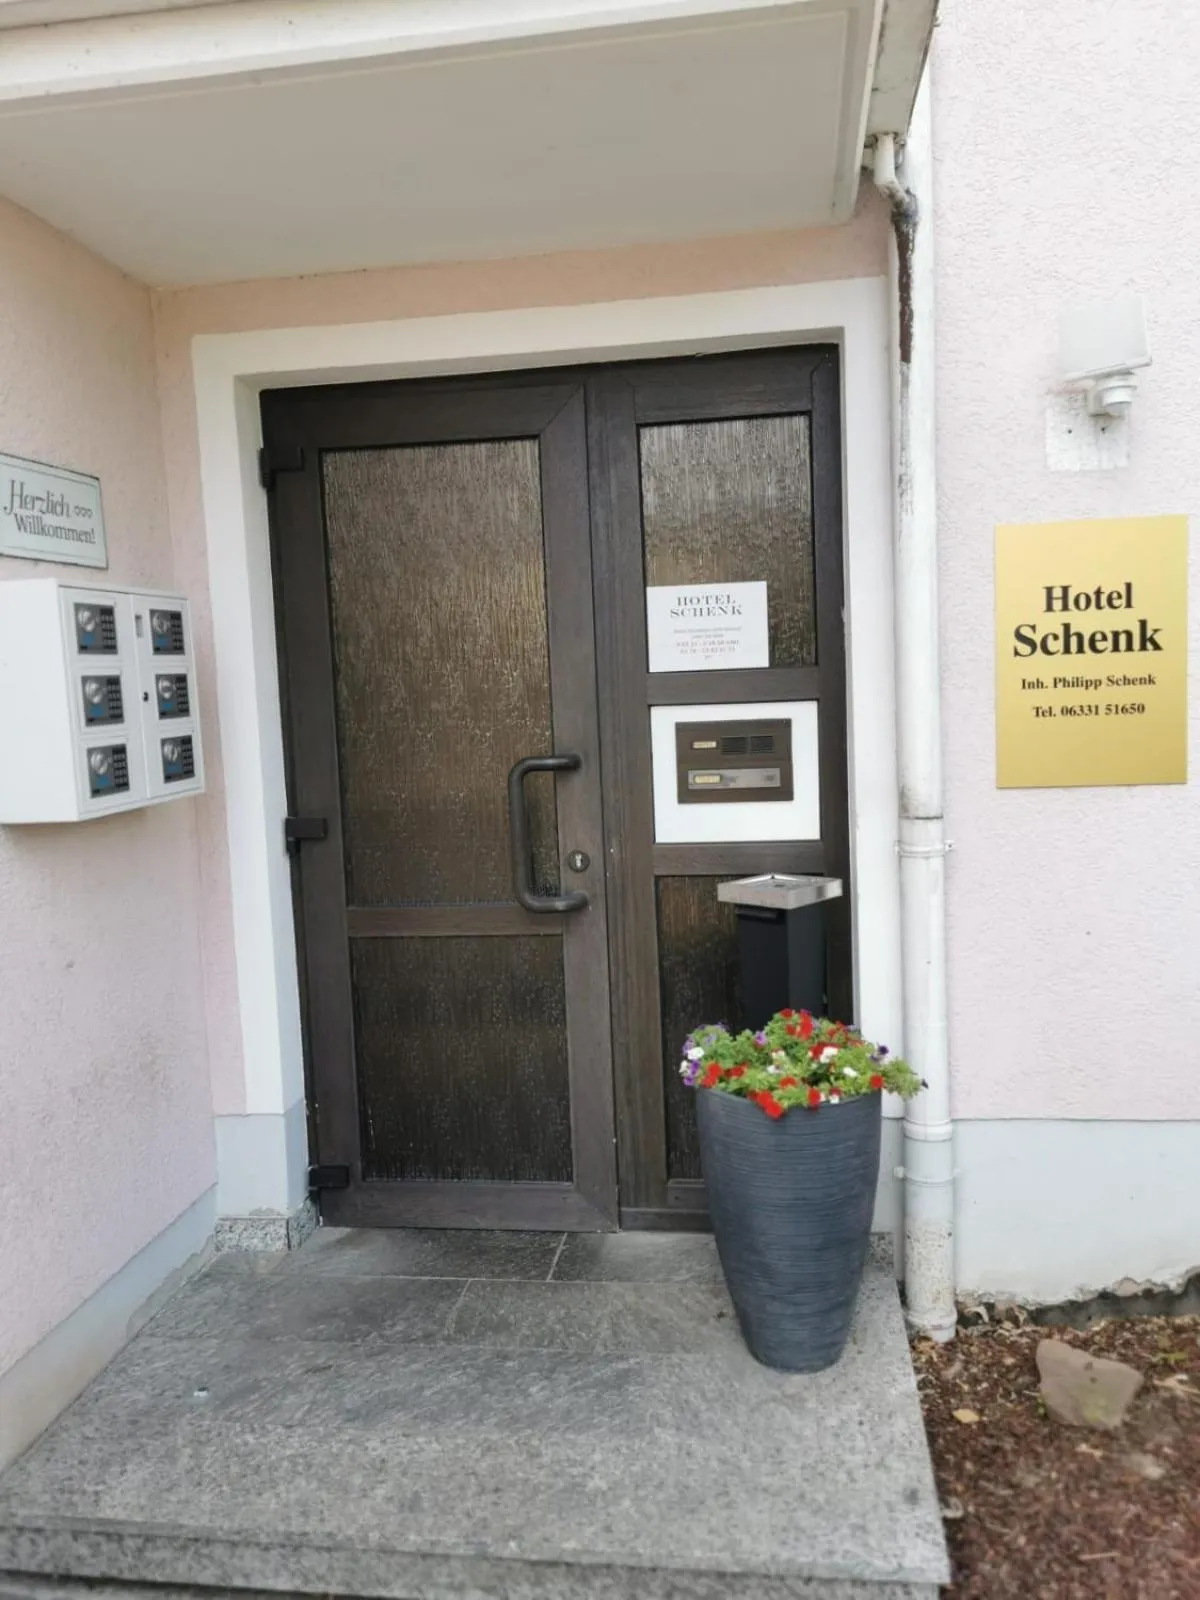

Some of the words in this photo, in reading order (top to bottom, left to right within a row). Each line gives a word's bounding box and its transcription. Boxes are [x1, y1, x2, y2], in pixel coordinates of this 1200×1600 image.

[3, 479, 71, 518] Herzlich
[14, 512, 96, 544] Willkommen!
[677, 594, 736, 606] HOTEL
[1042, 582, 1134, 613] Hotel
[670, 605, 742, 618] SCHENK
[1013, 619, 1163, 657] Schenk
[1021, 678, 1048, 690] Inh.
[1053, 676, 1102, 691] Philipp
[1106, 674, 1156, 687] Schenk
[1032, 706, 1056, 718] Tel.
[1060, 704, 1099, 717] 06331
[1104, 703, 1145, 716] 51650
